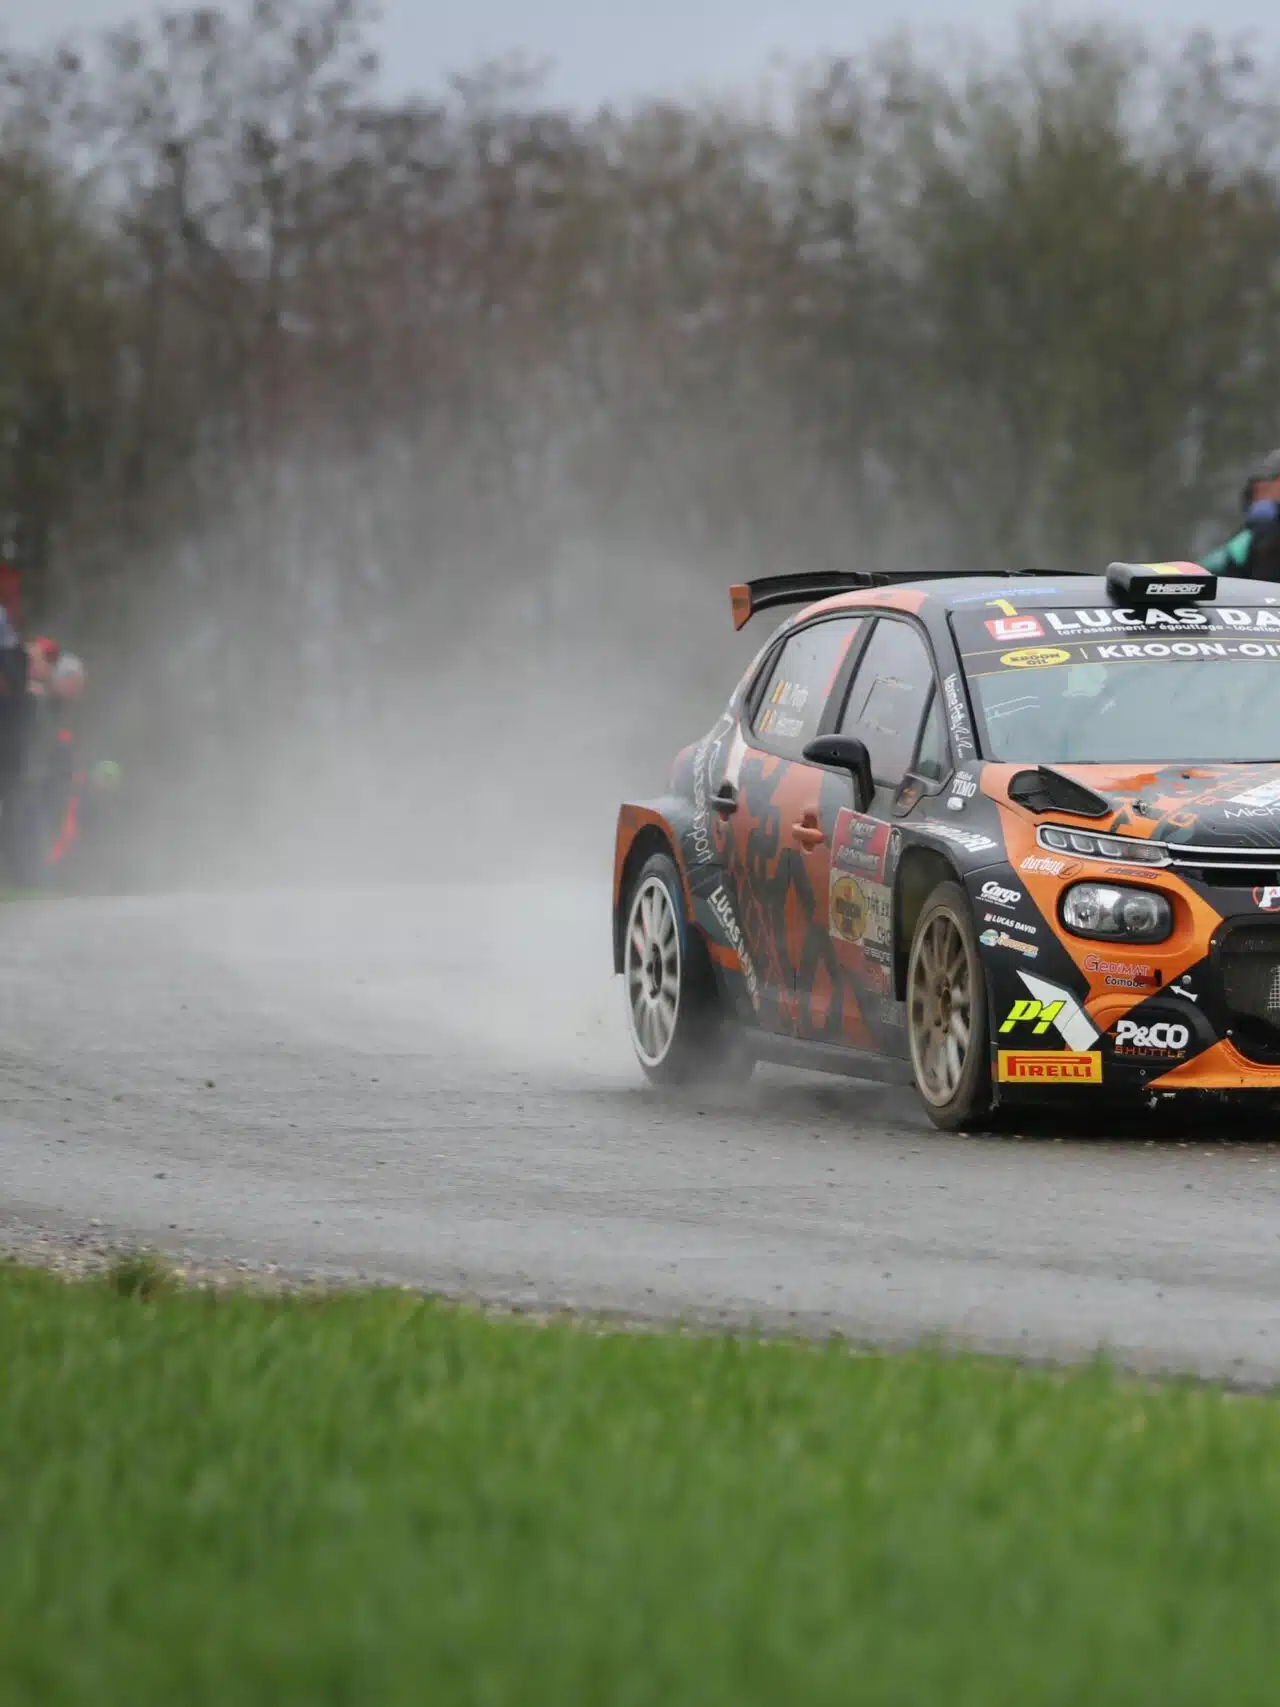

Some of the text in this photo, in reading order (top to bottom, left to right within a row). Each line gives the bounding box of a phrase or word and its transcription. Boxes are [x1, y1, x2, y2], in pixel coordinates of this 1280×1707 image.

[1045, 608, 1207, 630] LUCAS
[1056, 624, 1147, 636] terrassement
[1009, 652, 1061, 662] KROON
[981, 881, 1021, 903] Cargo
[710, 885, 741, 943] LUCAS
[992, 914, 1037, 934] LUCAS DAVID
[999, 999, 1067, 1034] P1
[1115, 1020, 1189, 1049] P&CO
[1115, 1045, 1187, 1058] SHUTTLE
[1007, 1055, 1092, 1078] PIRELLI
